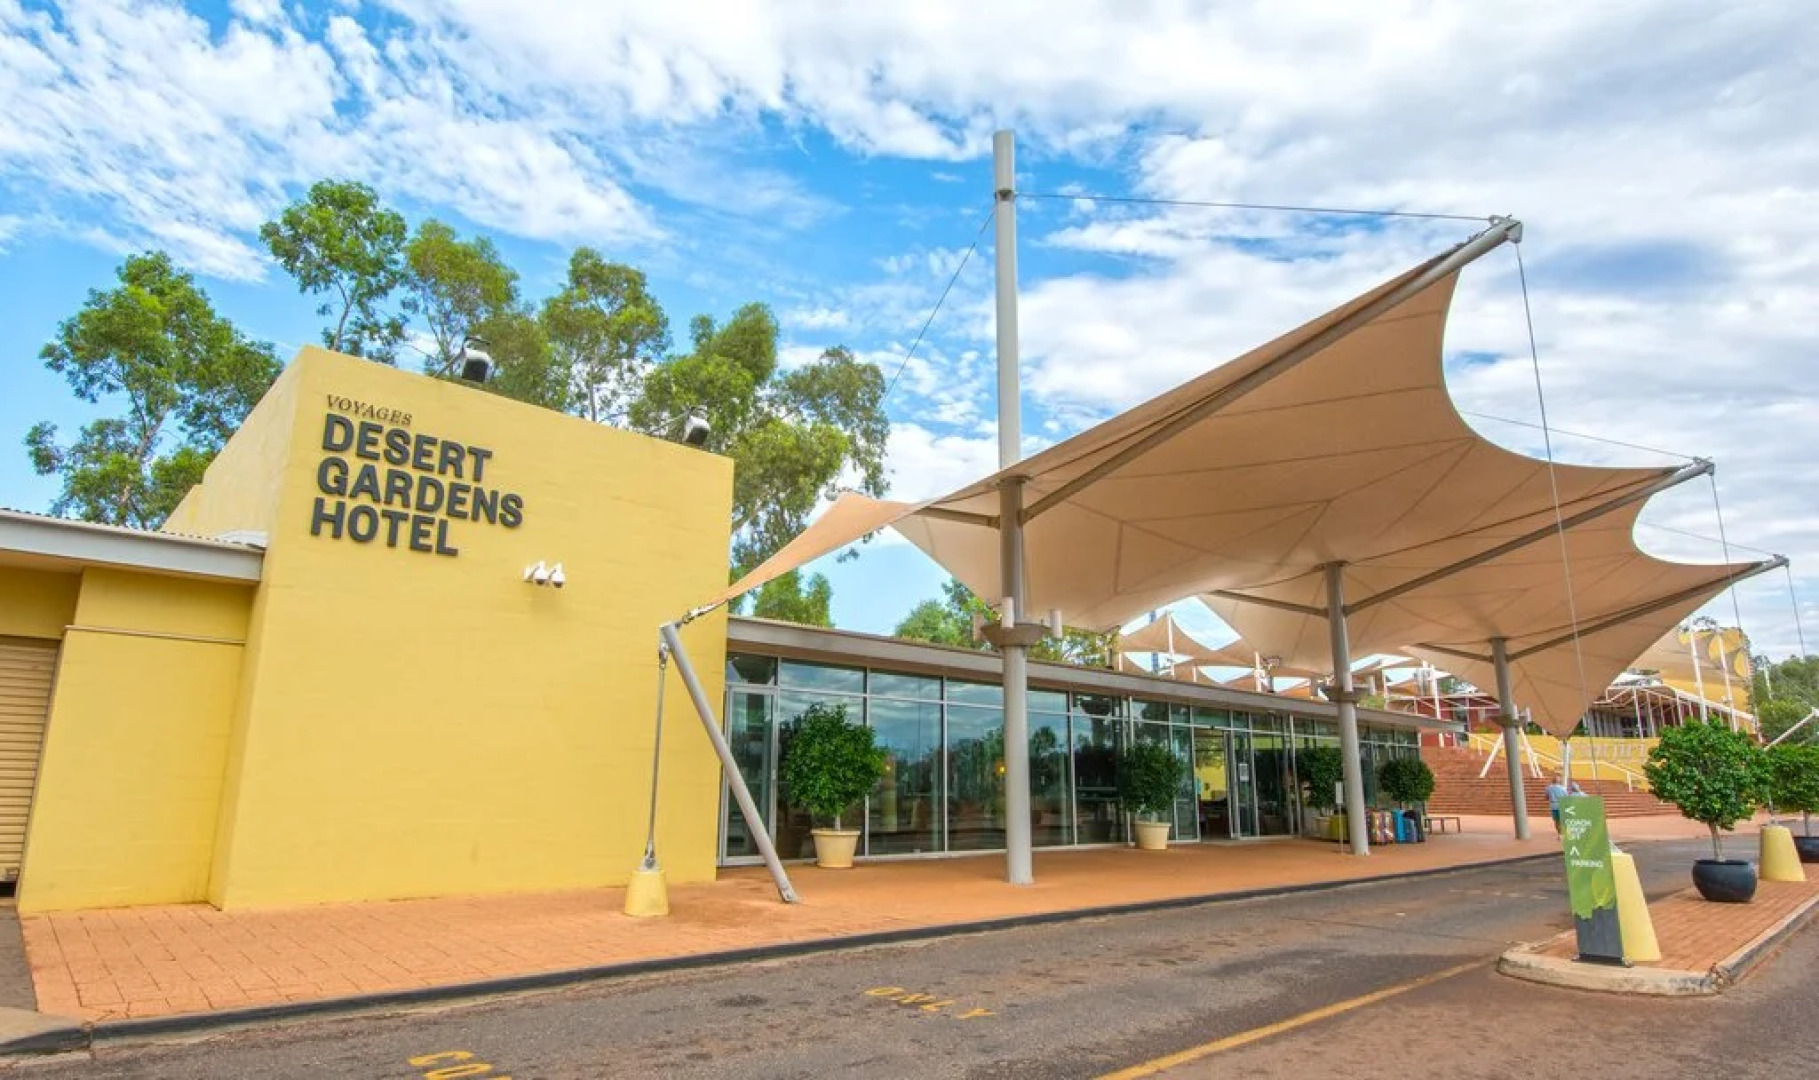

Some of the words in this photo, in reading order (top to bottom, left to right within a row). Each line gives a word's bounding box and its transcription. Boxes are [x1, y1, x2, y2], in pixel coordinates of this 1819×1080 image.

[327, 394, 413, 426] VOYAGES
[322, 413, 493, 482] DESERT
[317, 456, 525, 528] GARDENS
[310, 497, 459, 557] HOTEL
[1571, 859, 1604, 868] PARKING
